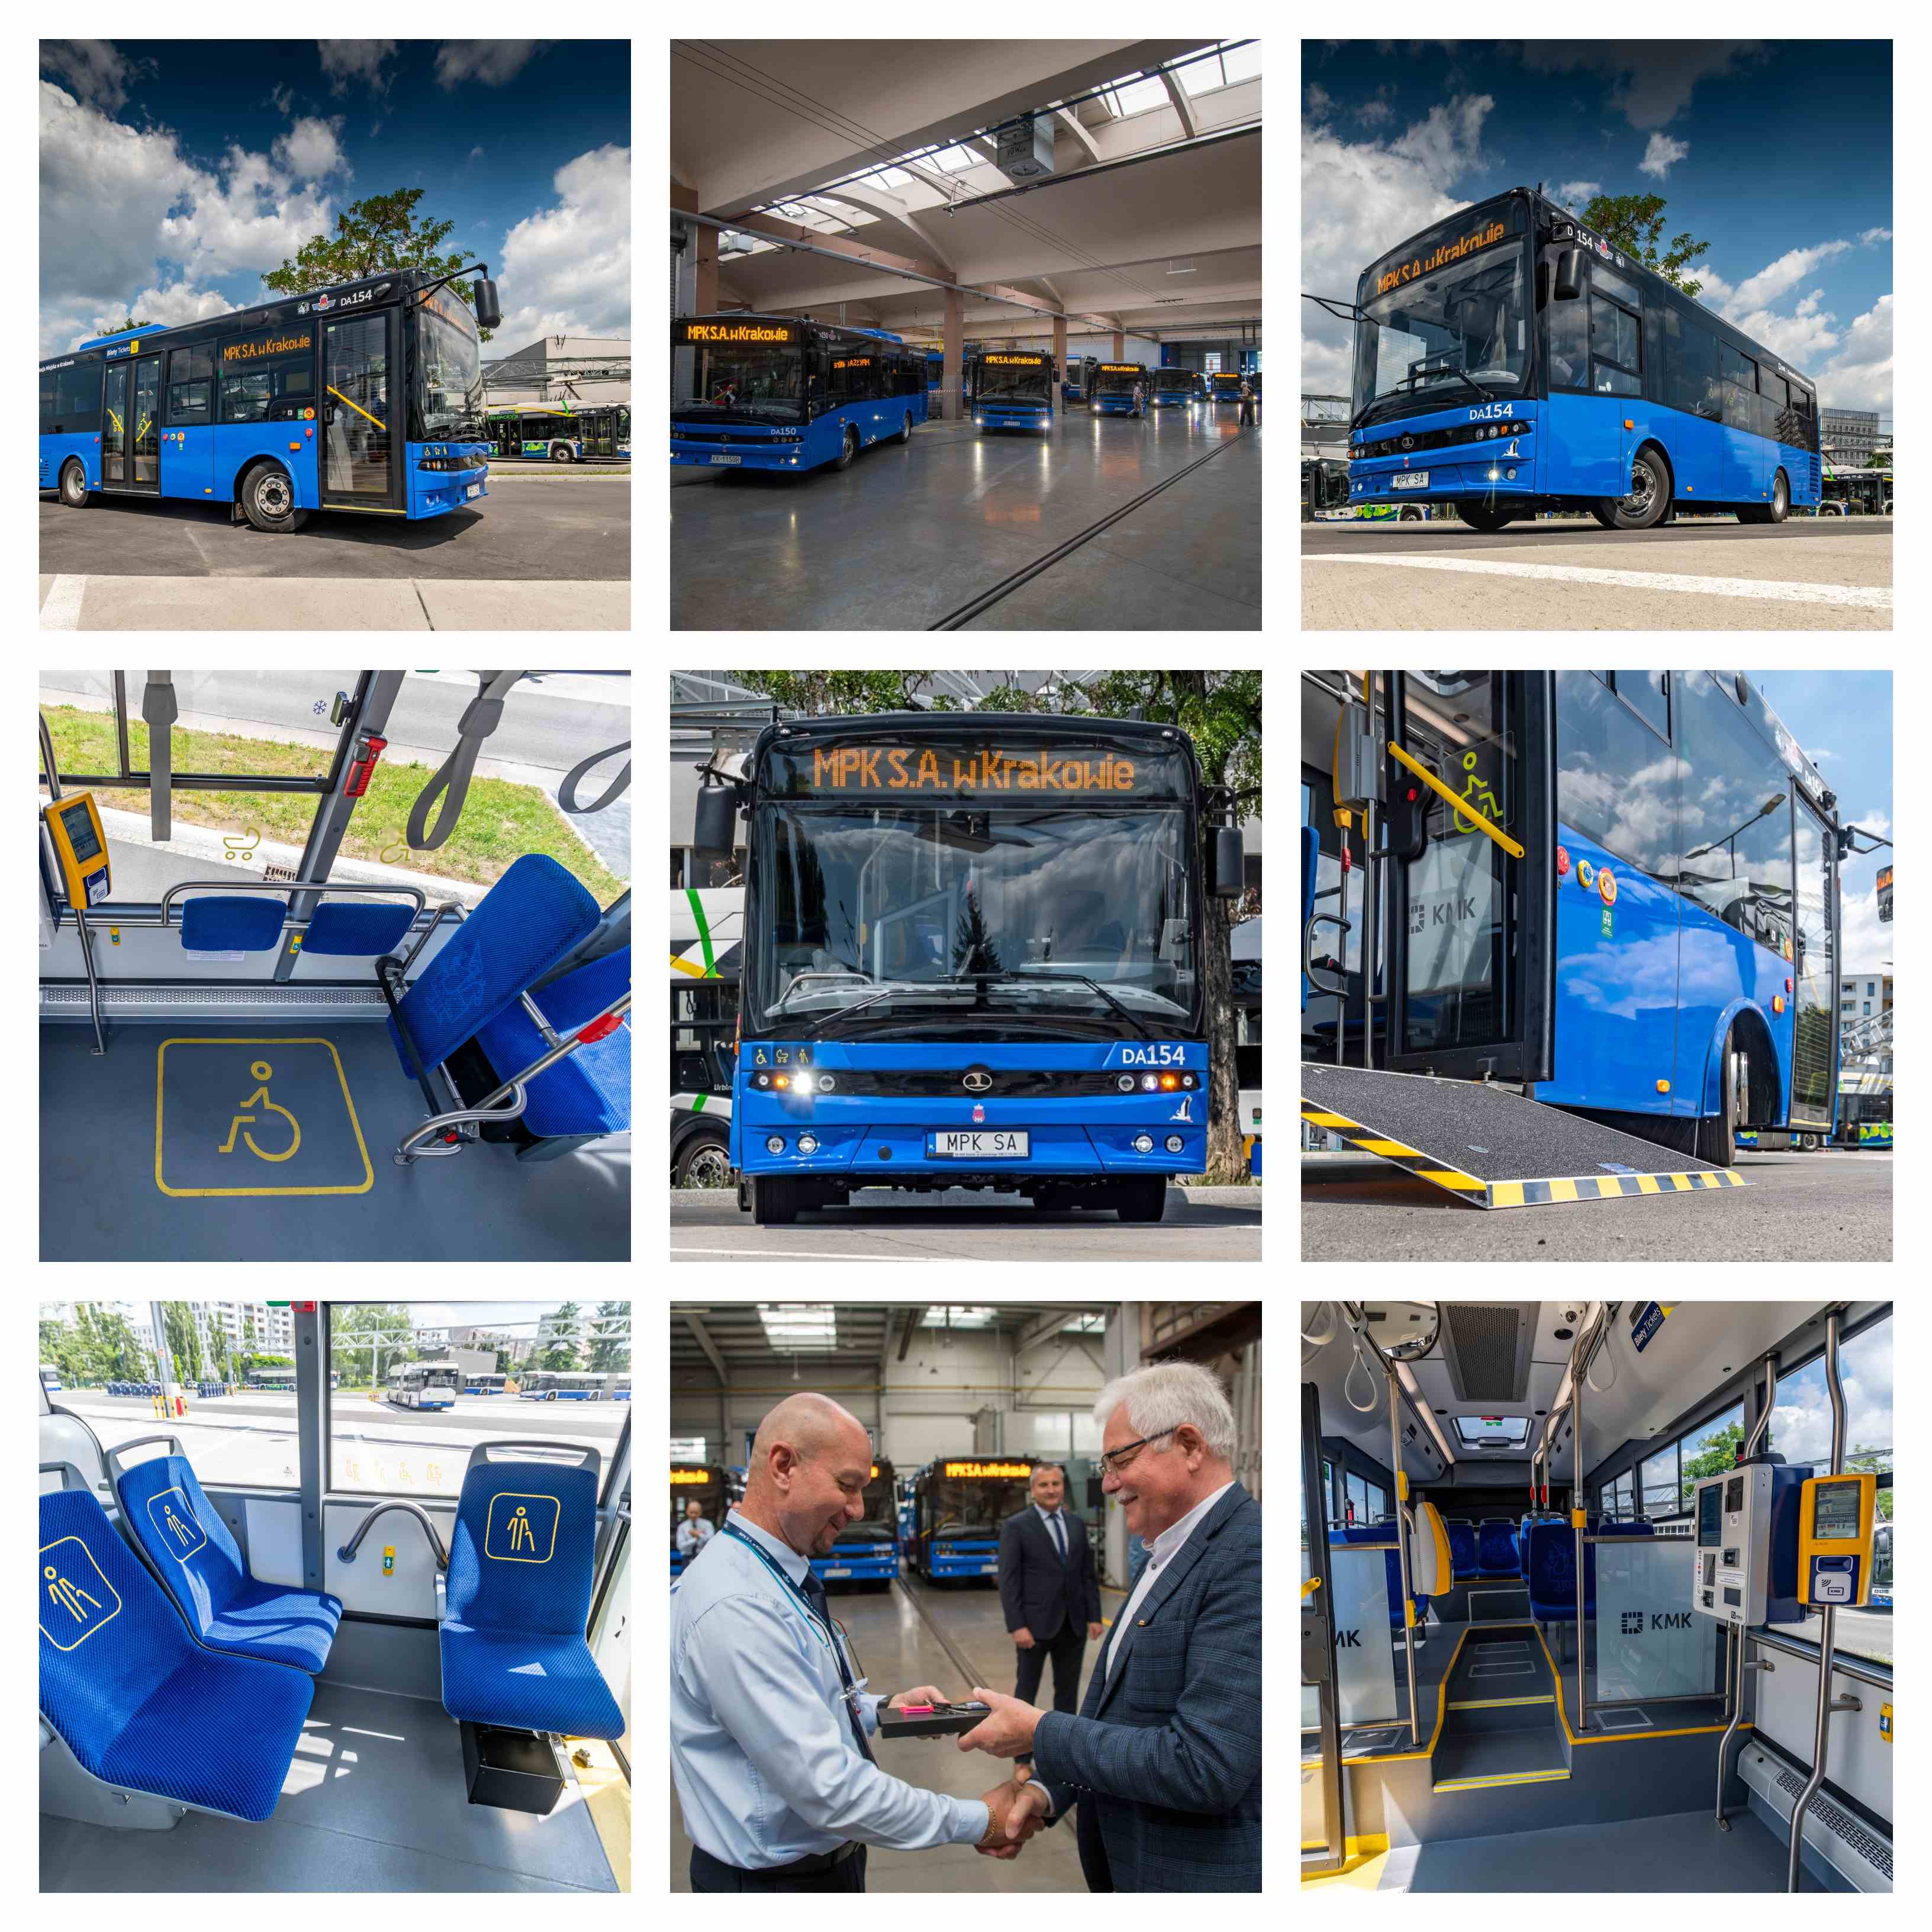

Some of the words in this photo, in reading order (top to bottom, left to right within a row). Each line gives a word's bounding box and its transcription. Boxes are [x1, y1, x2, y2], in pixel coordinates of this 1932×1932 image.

[341, 289, 372, 306] DA154
[688, 326, 709, 340] MPK
[710, 326, 729, 340] S.A.
[730, 329, 738, 340] w
[739, 326, 788, 341] Krakowie
[224, 346, 241, 361] MPK
[242, 343, 257, 358] S.A.
[259, 347, 265, 355] w
[266, 334, 311, 354] Krakowie
[1014, 356, 1041, 365] Krakowie
[1470, 404, 1513, 420] DA154
[1396, 474, 1410, 487] MPK
[1414, 473, 1424, 485] SA
[814, 748, 881, 787] MPK
[887, 748, 948, 787] S.A.
[953, 759, 977, 788] w
[983, 749, 1135, 790] Krakowie
[1432, 896, 1476, 926] KMK
[1122, 1045, 1185, 1065] DA154
[947, 1134, 982, 1151] MPK
[994, 1134, 1016, 1151] SA
[1634, 1328, 1647, 1347] Bilety
[1644, 1307, 1661, 1331] Tickets
[1651, 1612, 1692, 1630] KMK
